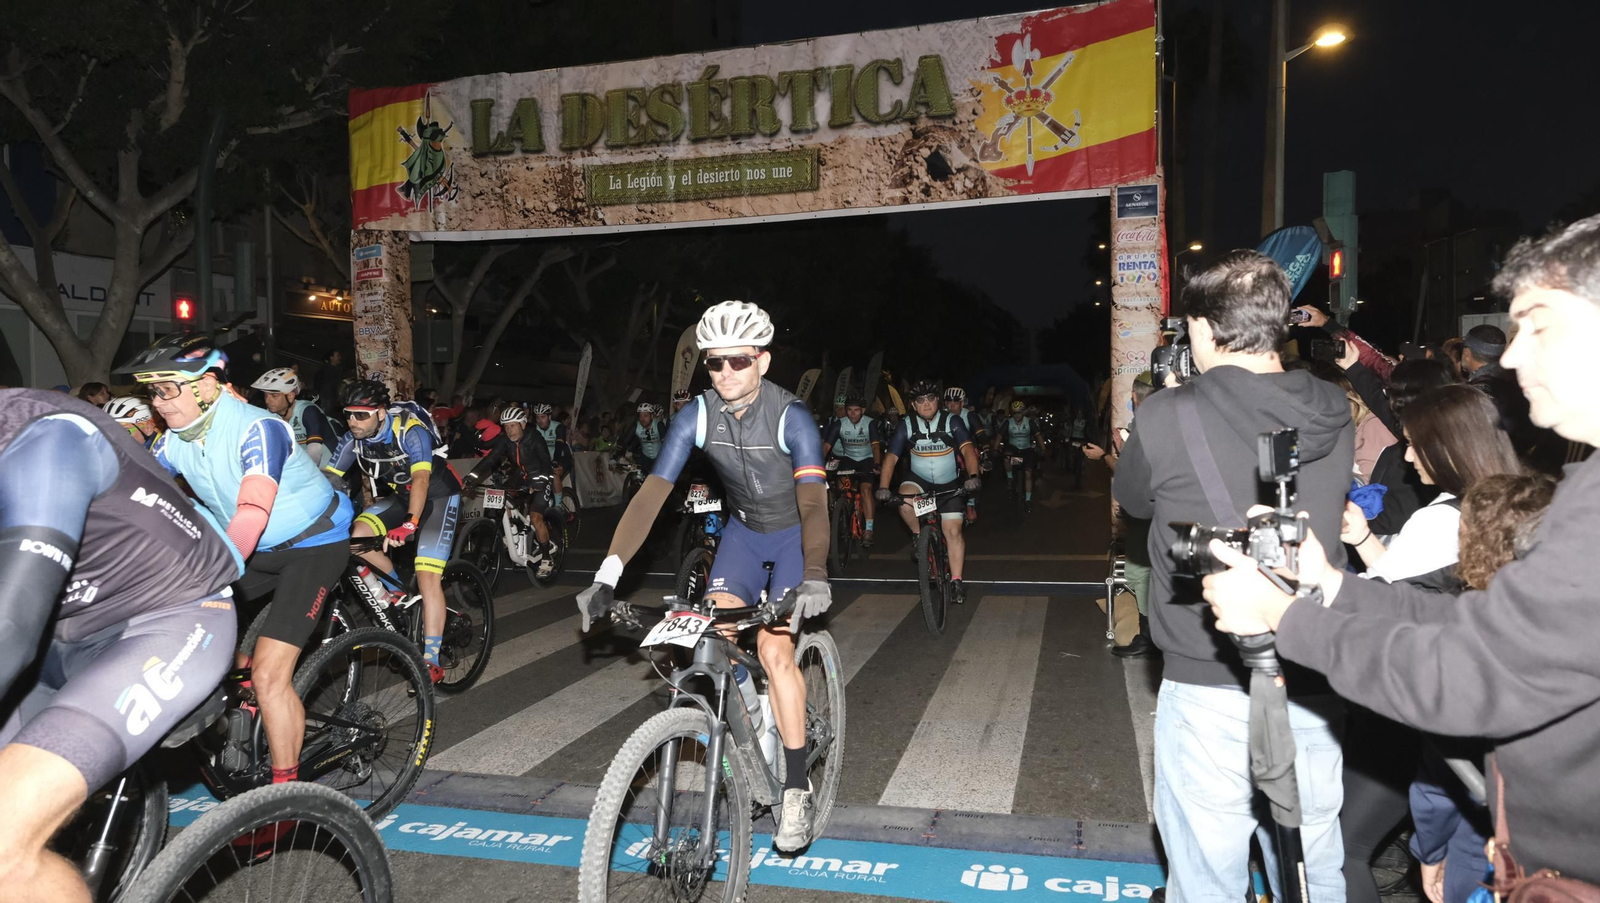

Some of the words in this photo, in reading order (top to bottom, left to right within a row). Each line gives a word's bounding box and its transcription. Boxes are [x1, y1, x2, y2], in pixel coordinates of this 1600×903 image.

[470, 97, 546, 157] LA
[560, 54, 957, 148] DESÉRTICA
[609, 175, 622, 190] La
[626, 172, 663, 191] Legión
[669, 174, 676, 189] y
[682, 170, 692, 185] el
[697, 168, 740, 184] desierto
[746, 165, 766, 181] nos
[772, 165, 793, 178] une
[1118, 261, 1157, 271] RENTA
[1118, 271, 1158, 284] TODO
[320, 300, 354, 313] AUTO
[358, 326, 382, 336] BBVA
[486, 495, 503, 503] 9019
[917, 497, 935, 510] 8963
[156, 497, 202, 540] METALICAS
[201, 601, 231, 611] FASTER
[351, 575, 397, 634] MONDRAKE
[657, 617, 703, 635] 7843
[415, 719, 433, 767] MAXXIS
[398, 821, 574, 847] cajamar
[468, 840, 504, 849] CAJA
[506, 843, 552, 853] RURAL
[788, 868, 833, 877] CAJA
[833, 873, 887, 884] RURAL
